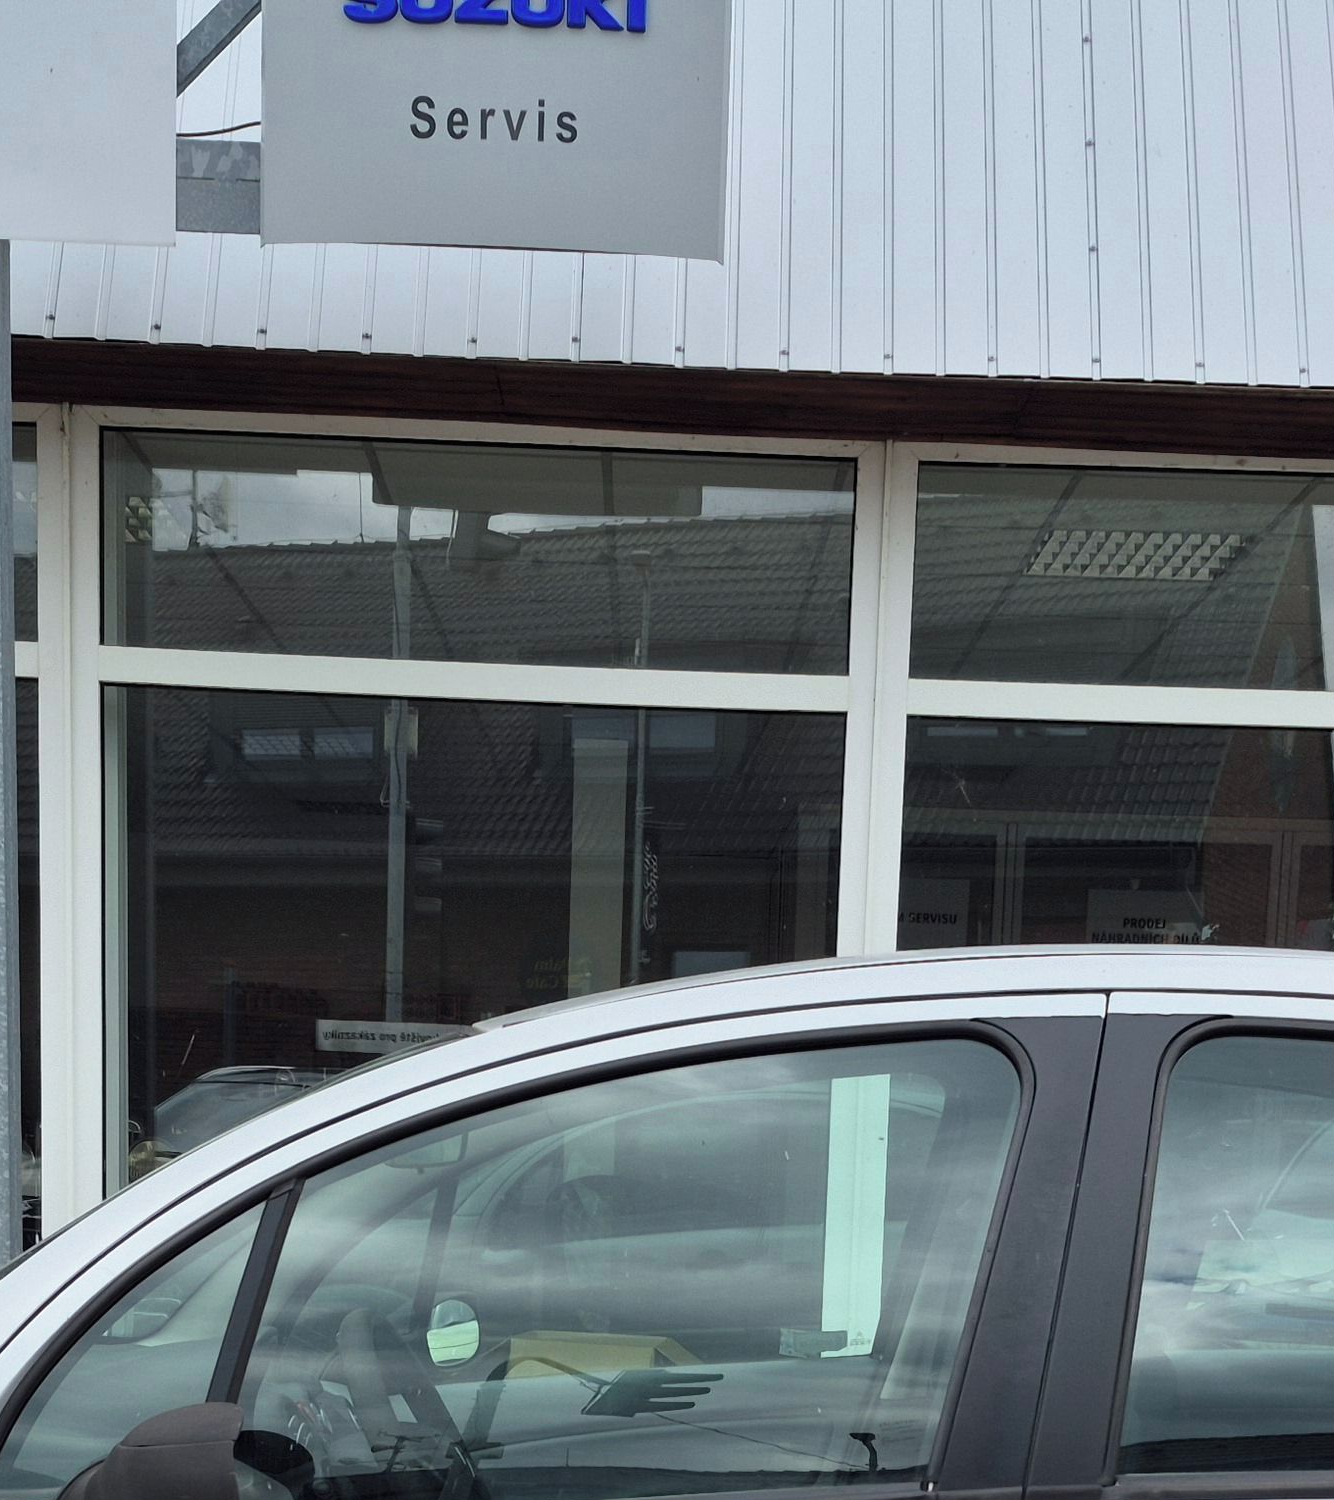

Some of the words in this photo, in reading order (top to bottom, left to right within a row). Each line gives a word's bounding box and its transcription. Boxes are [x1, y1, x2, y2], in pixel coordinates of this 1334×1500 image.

[409, 95, 579, 144] Servis
[908, 911, 958, 925] SERVISU
[1122, 917, 1167, 929] PRODEJ
